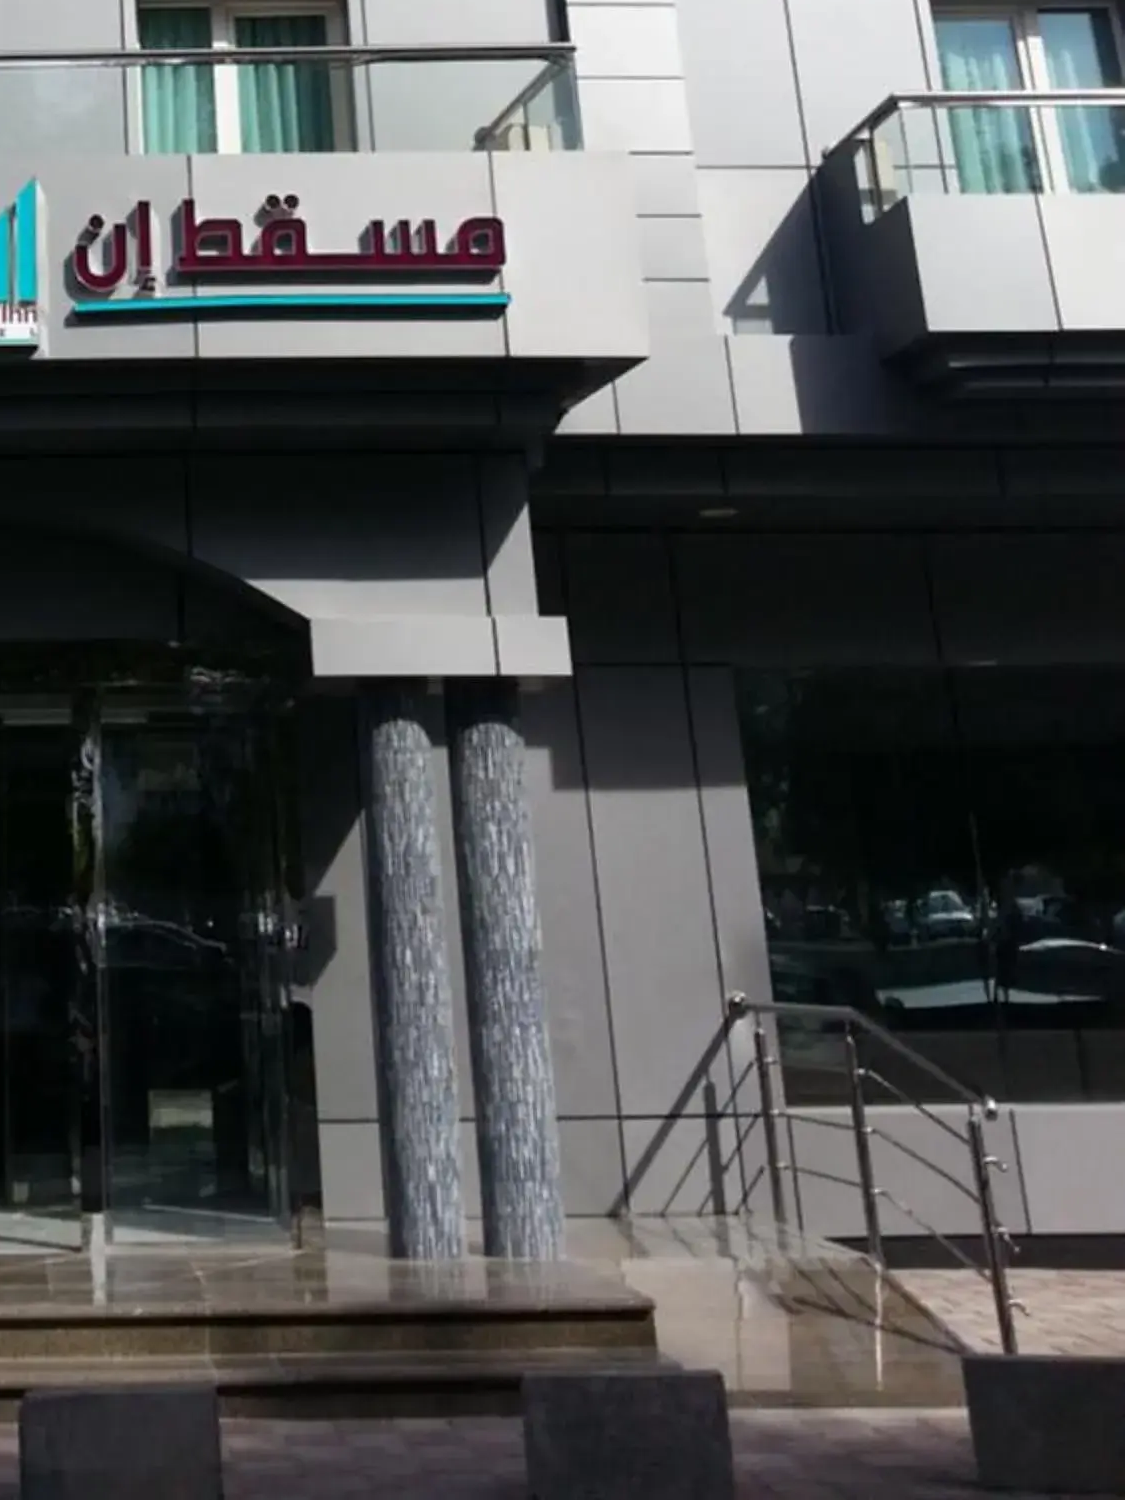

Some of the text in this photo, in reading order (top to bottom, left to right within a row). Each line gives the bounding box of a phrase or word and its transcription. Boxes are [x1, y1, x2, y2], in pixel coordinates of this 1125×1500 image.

[74, 194, 507, 292] مسقط إن
[2, 304, 38, 324] Inn
